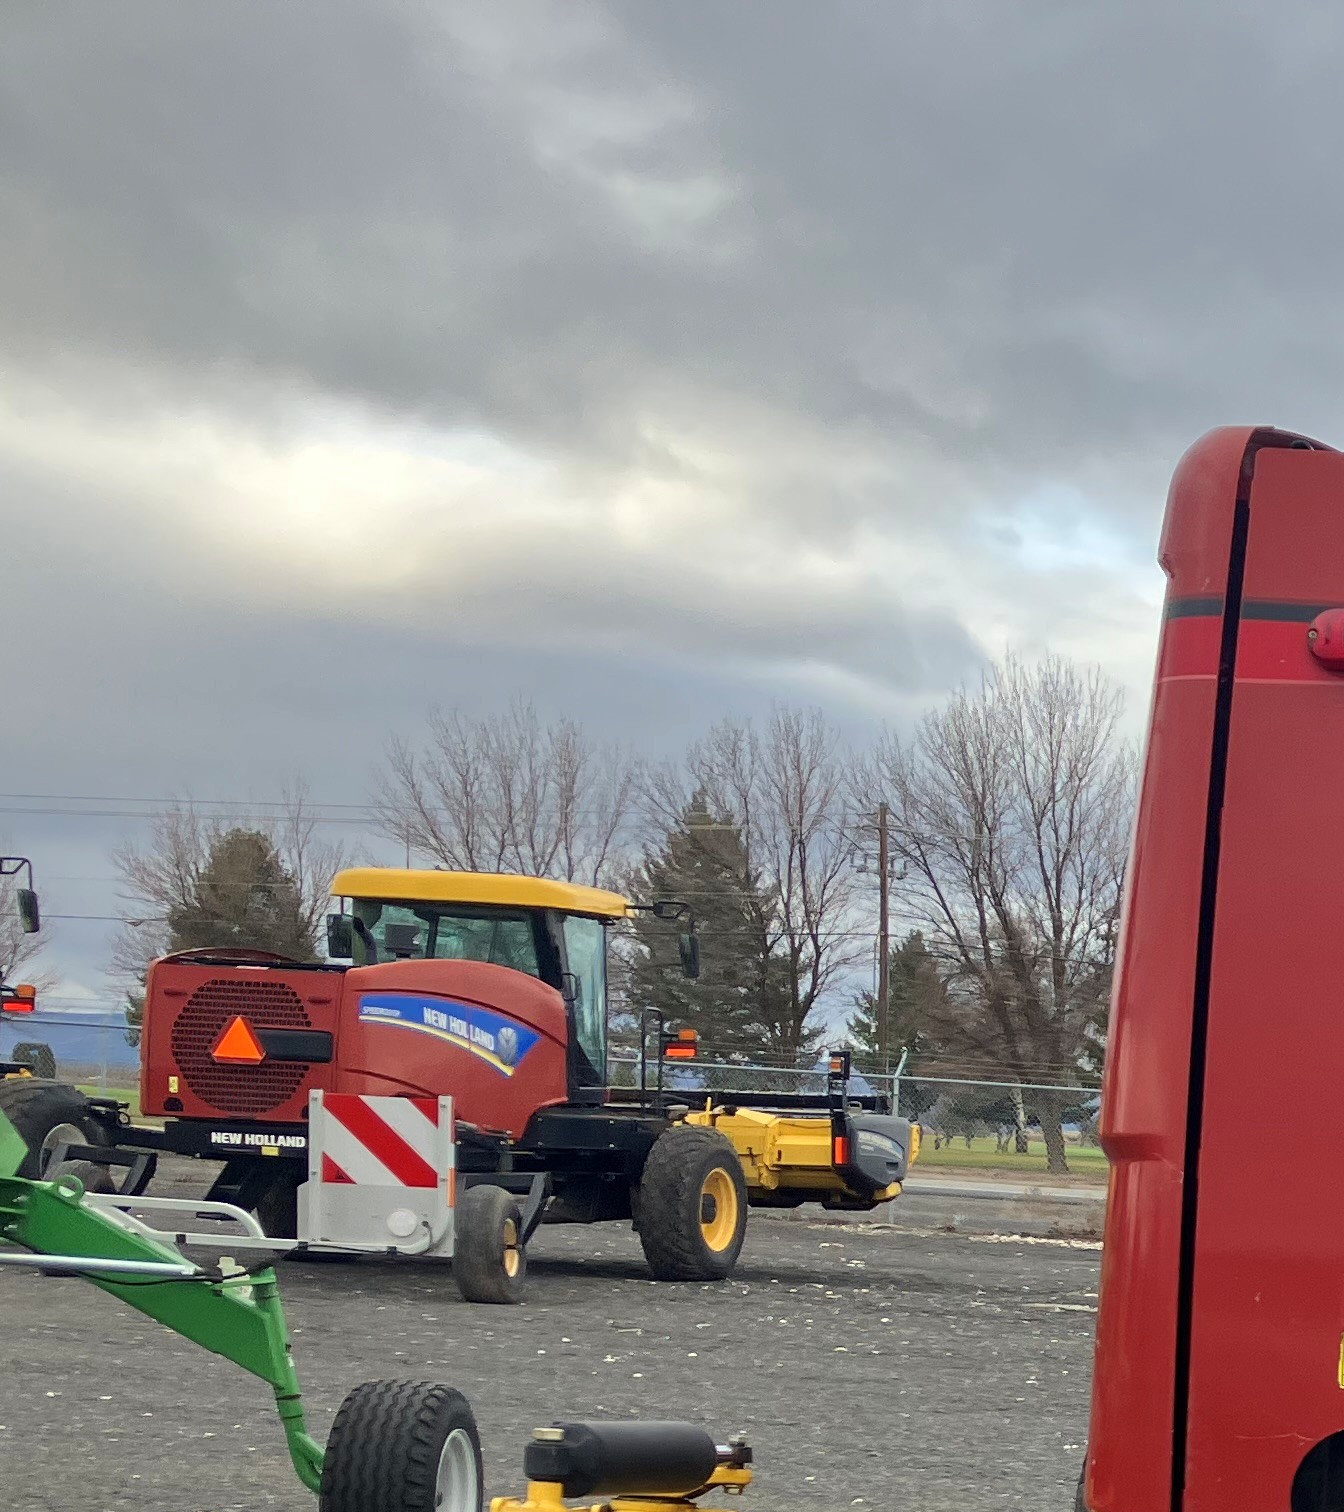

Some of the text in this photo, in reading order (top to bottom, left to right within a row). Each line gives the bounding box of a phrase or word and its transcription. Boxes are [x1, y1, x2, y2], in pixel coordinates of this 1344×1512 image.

[423, 1007, 495, 1050] NEW HOLLAND
[211, 1132, 306, 1148] NEW HOLLAND
